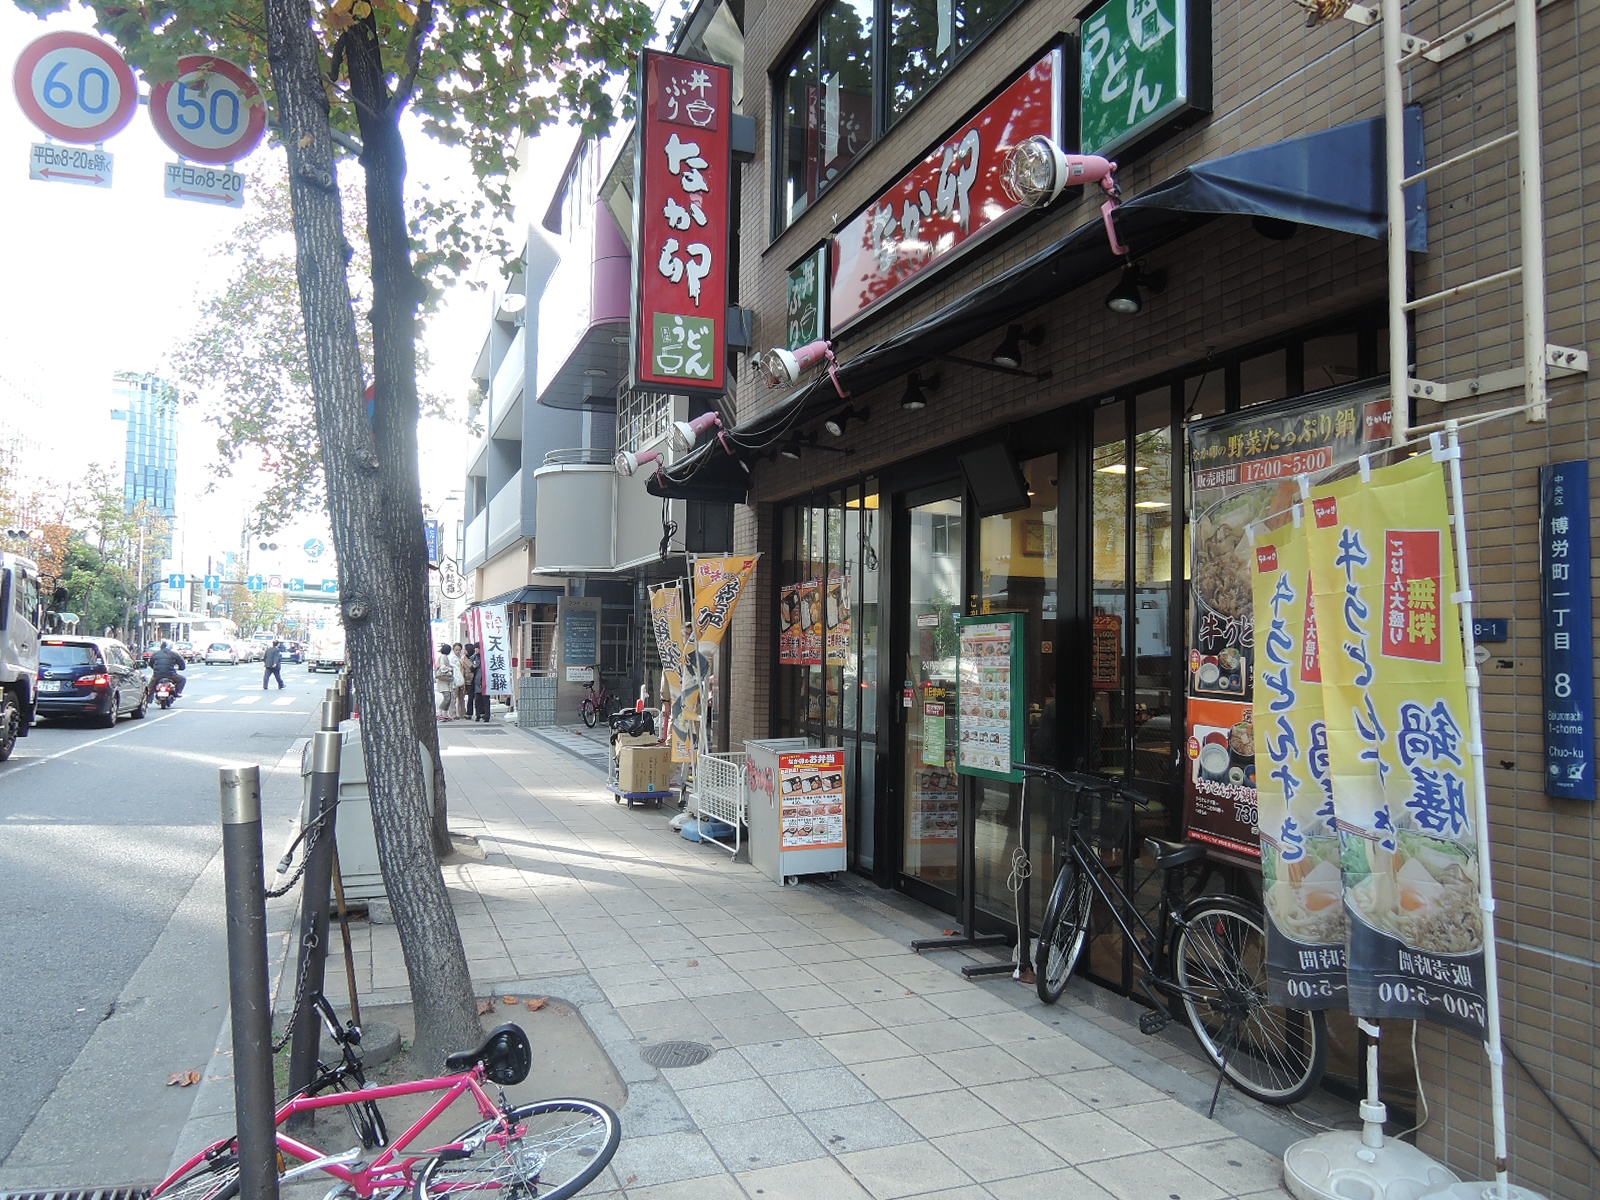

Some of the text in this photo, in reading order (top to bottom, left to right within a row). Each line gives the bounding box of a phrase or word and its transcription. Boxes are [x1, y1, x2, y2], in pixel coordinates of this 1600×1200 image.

[43, 61, 110, 115] 60
[665, 69, 713, 120] 丼 ぶり
[1088, 14, 1162, 125] うどん
[176, 82, 240, 135] 50
[168, 163, 242, 192] 平日の8-20
[871, 127, 980, 275] なか卯
[658, 133, 713, 307] なか卯
[672, 315, 711, 377] うどん
[1197, 467, 1236, 487] 販売時間
[1554, 475, 1564, 506] 中央区
[1551, 516, 1570, 651] 博労町一丁目
[1474, 623, 1497, 637] 8-1
[1555, 673, 1572, 698] 8
[1548, 746, 1584, 758] Chuo-ku
[1233, 803, 1259, 827] 730
